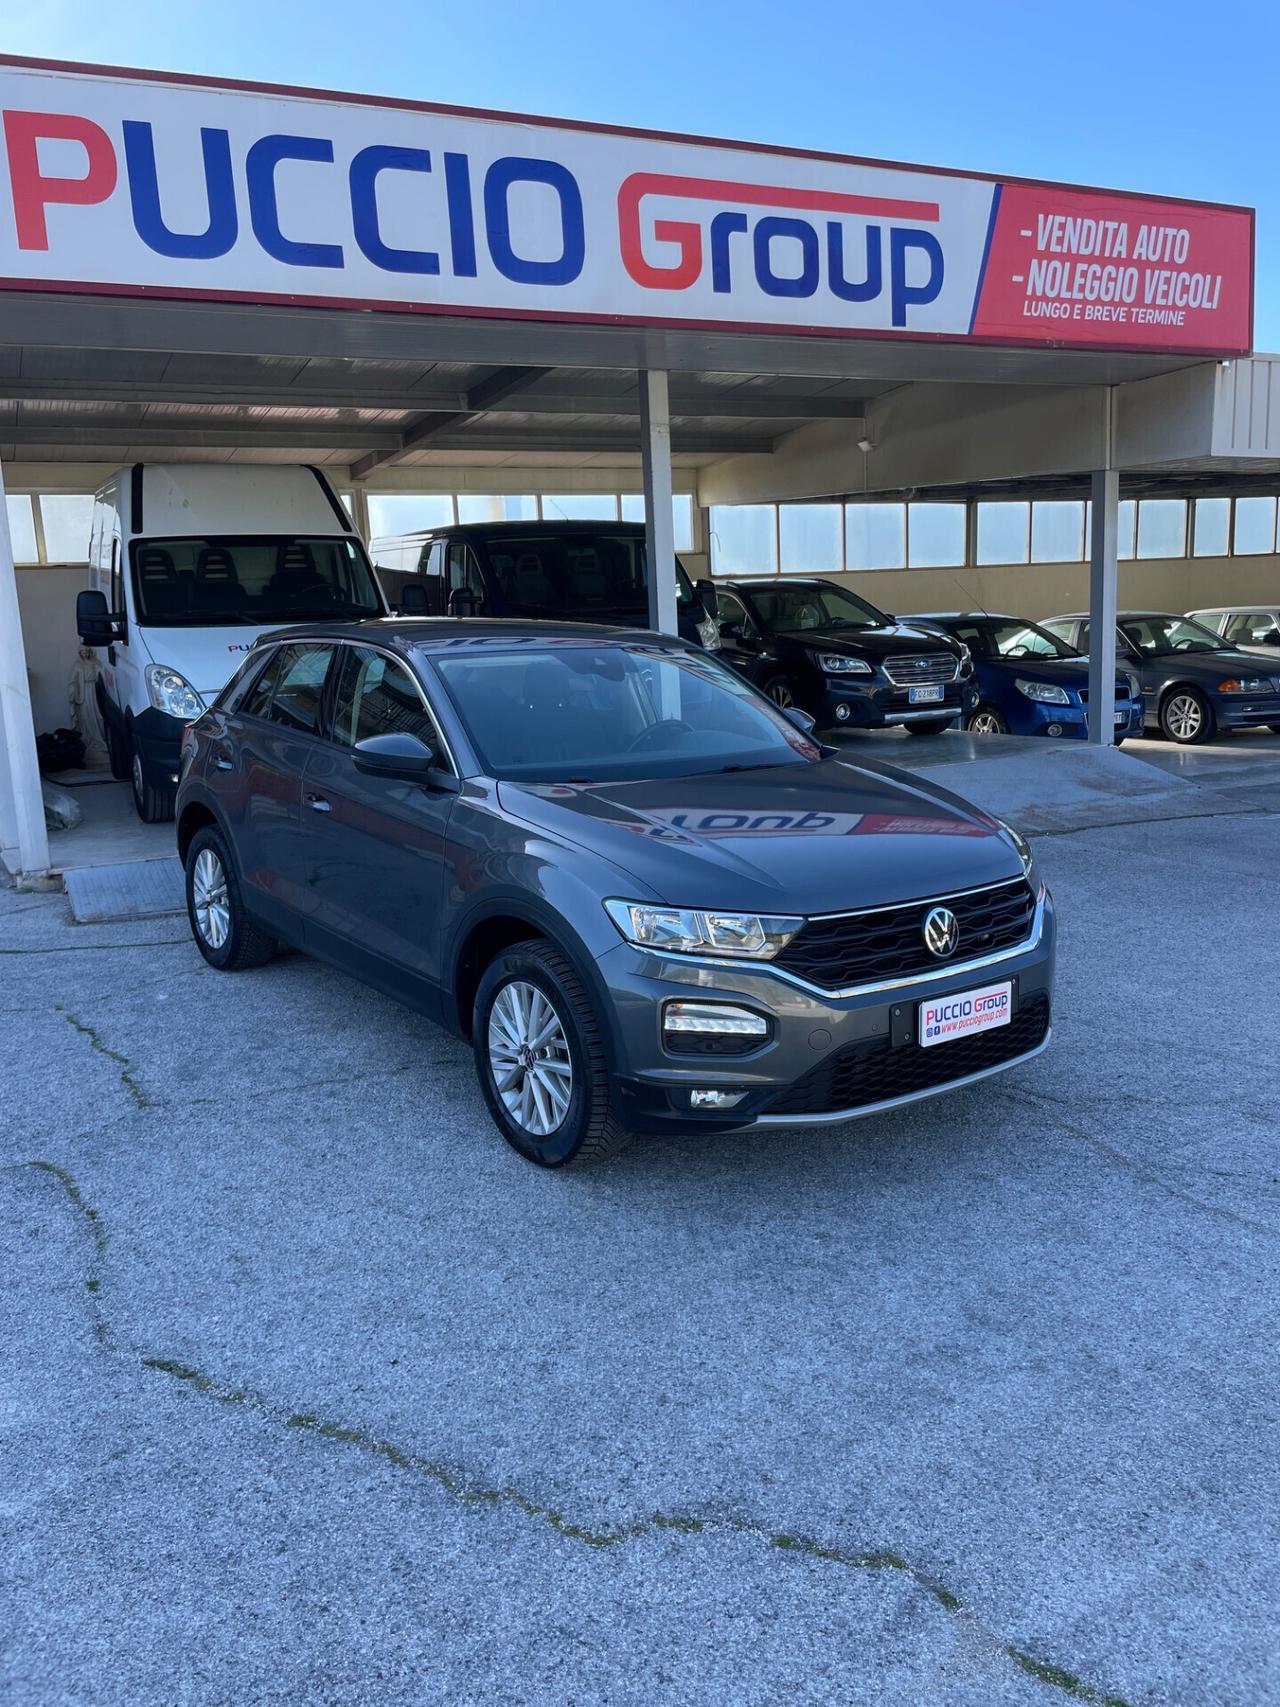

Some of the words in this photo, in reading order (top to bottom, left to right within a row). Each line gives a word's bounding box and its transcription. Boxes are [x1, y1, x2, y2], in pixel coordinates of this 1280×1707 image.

[2, 109, 585, 287] PUCCIO
[617, 172, 944, 328] Group
[1132, 224, 1191, 265] AUTO
[1144, 268, 1222, 310] VEICOLI
[1023, 300, 1070, 320] LUNGO
[1072, 304, 1082, 320] E
[1084, 305, 1127, 323] BREVE
[1130, 307, 1186, 326] TERMINE
[926, 1000, 972, 1026] PUCCIO
[974, 991, 1008, 1013] Group
[941, 1007, 1008, 1034] www.pucciogroup.com
